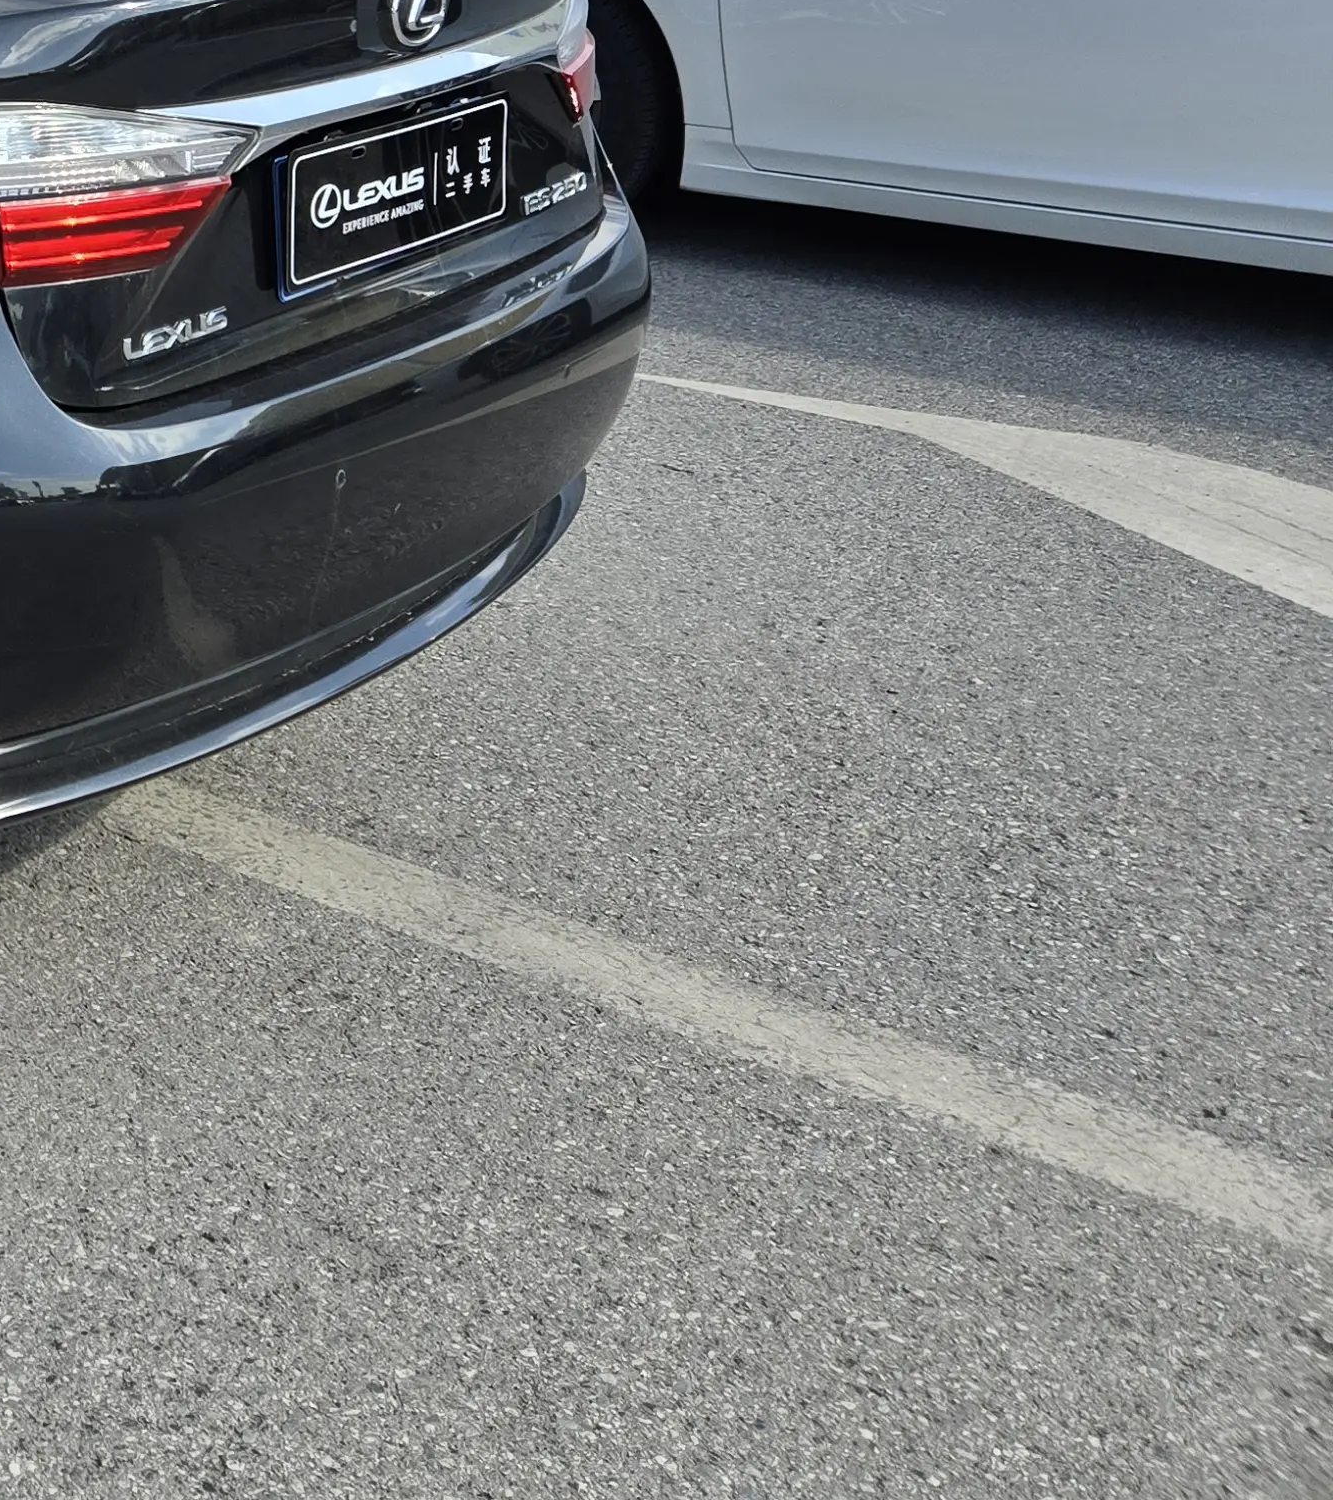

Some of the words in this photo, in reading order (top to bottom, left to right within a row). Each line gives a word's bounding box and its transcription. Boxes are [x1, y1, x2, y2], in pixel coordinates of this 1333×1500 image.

[445, 135, 492, 176] 认证
[343, 166, 425, 211] LEXUS
[342, 210, 390, 235] EXPERIENCE
[390, 198, 425, 218] AMAZING
[122, 305, 229, 361] LEXUS
